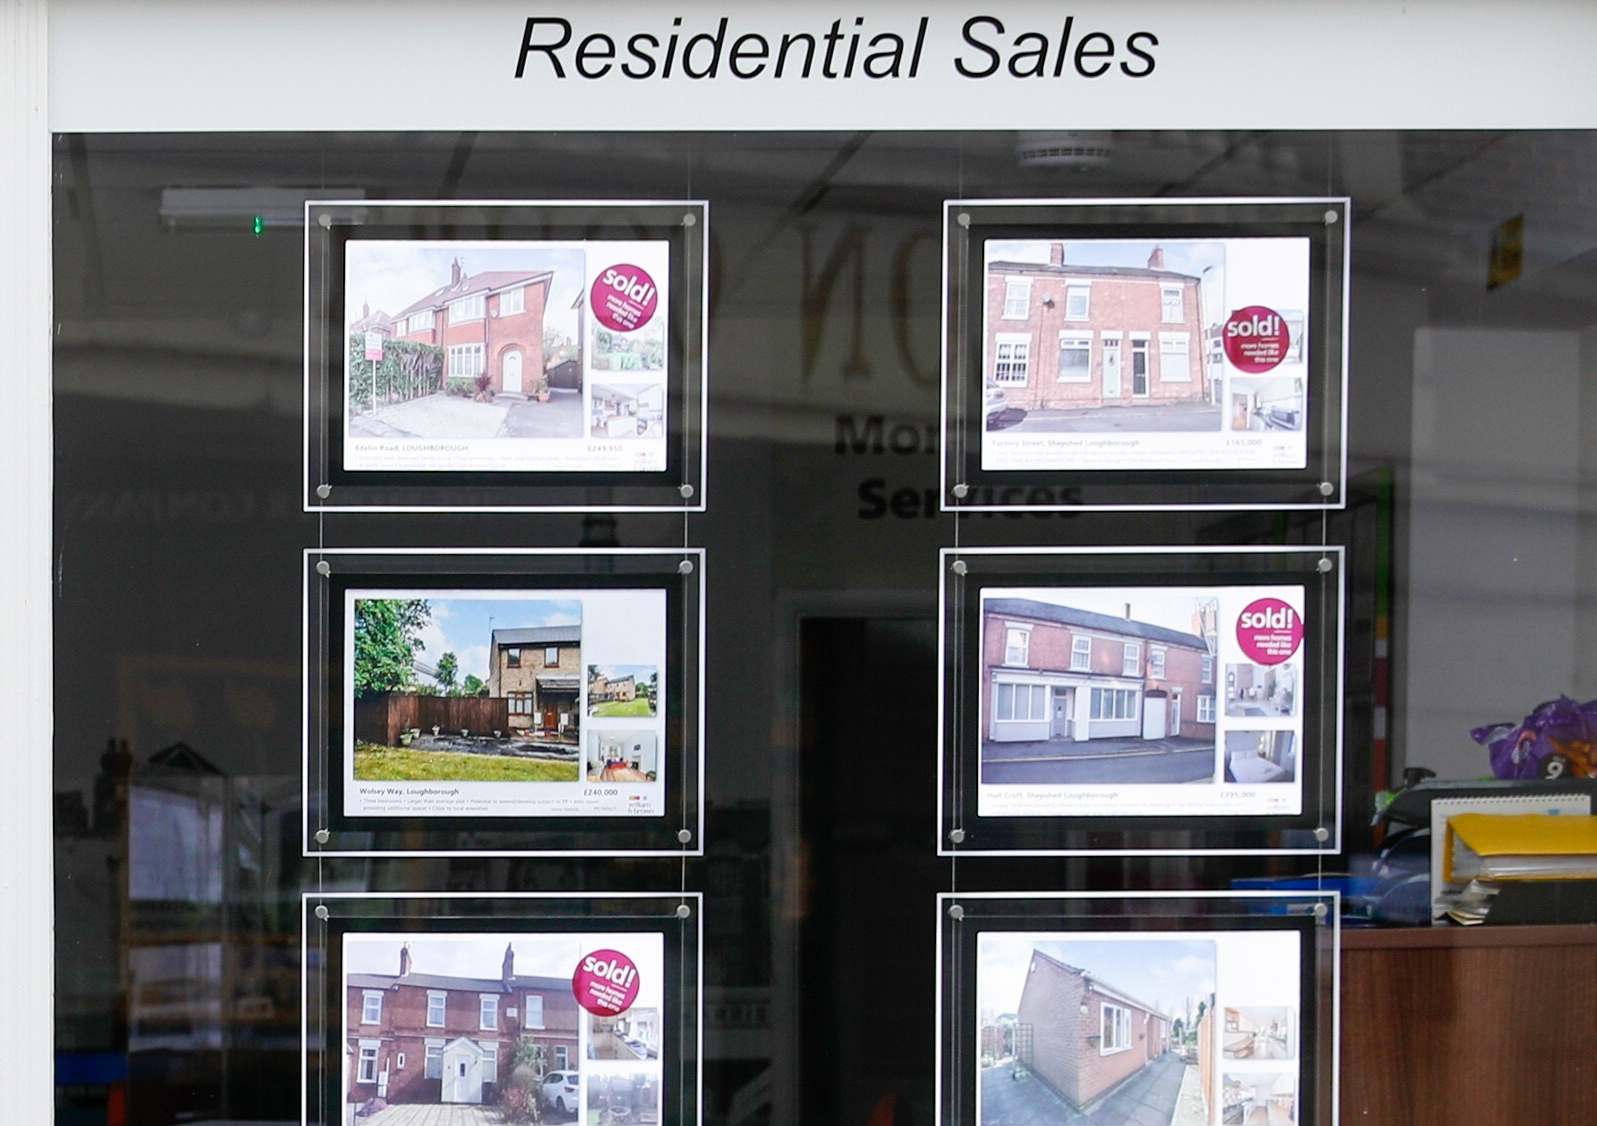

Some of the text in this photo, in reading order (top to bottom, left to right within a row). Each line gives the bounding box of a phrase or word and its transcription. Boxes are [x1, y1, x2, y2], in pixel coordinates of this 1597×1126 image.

[514, 15, 1160, 81] Residential Sales
[602, 269, 655, 306] sold!
[1227, 314, 1280, 337] sold!
[857, 479, 1082, 519] Services
[1241, 607, 1293, 629] sold!
[359, 788, 618, 796] Wolsey Way, Loughborough £240,000
[582, 956, 636, 988] sold!
